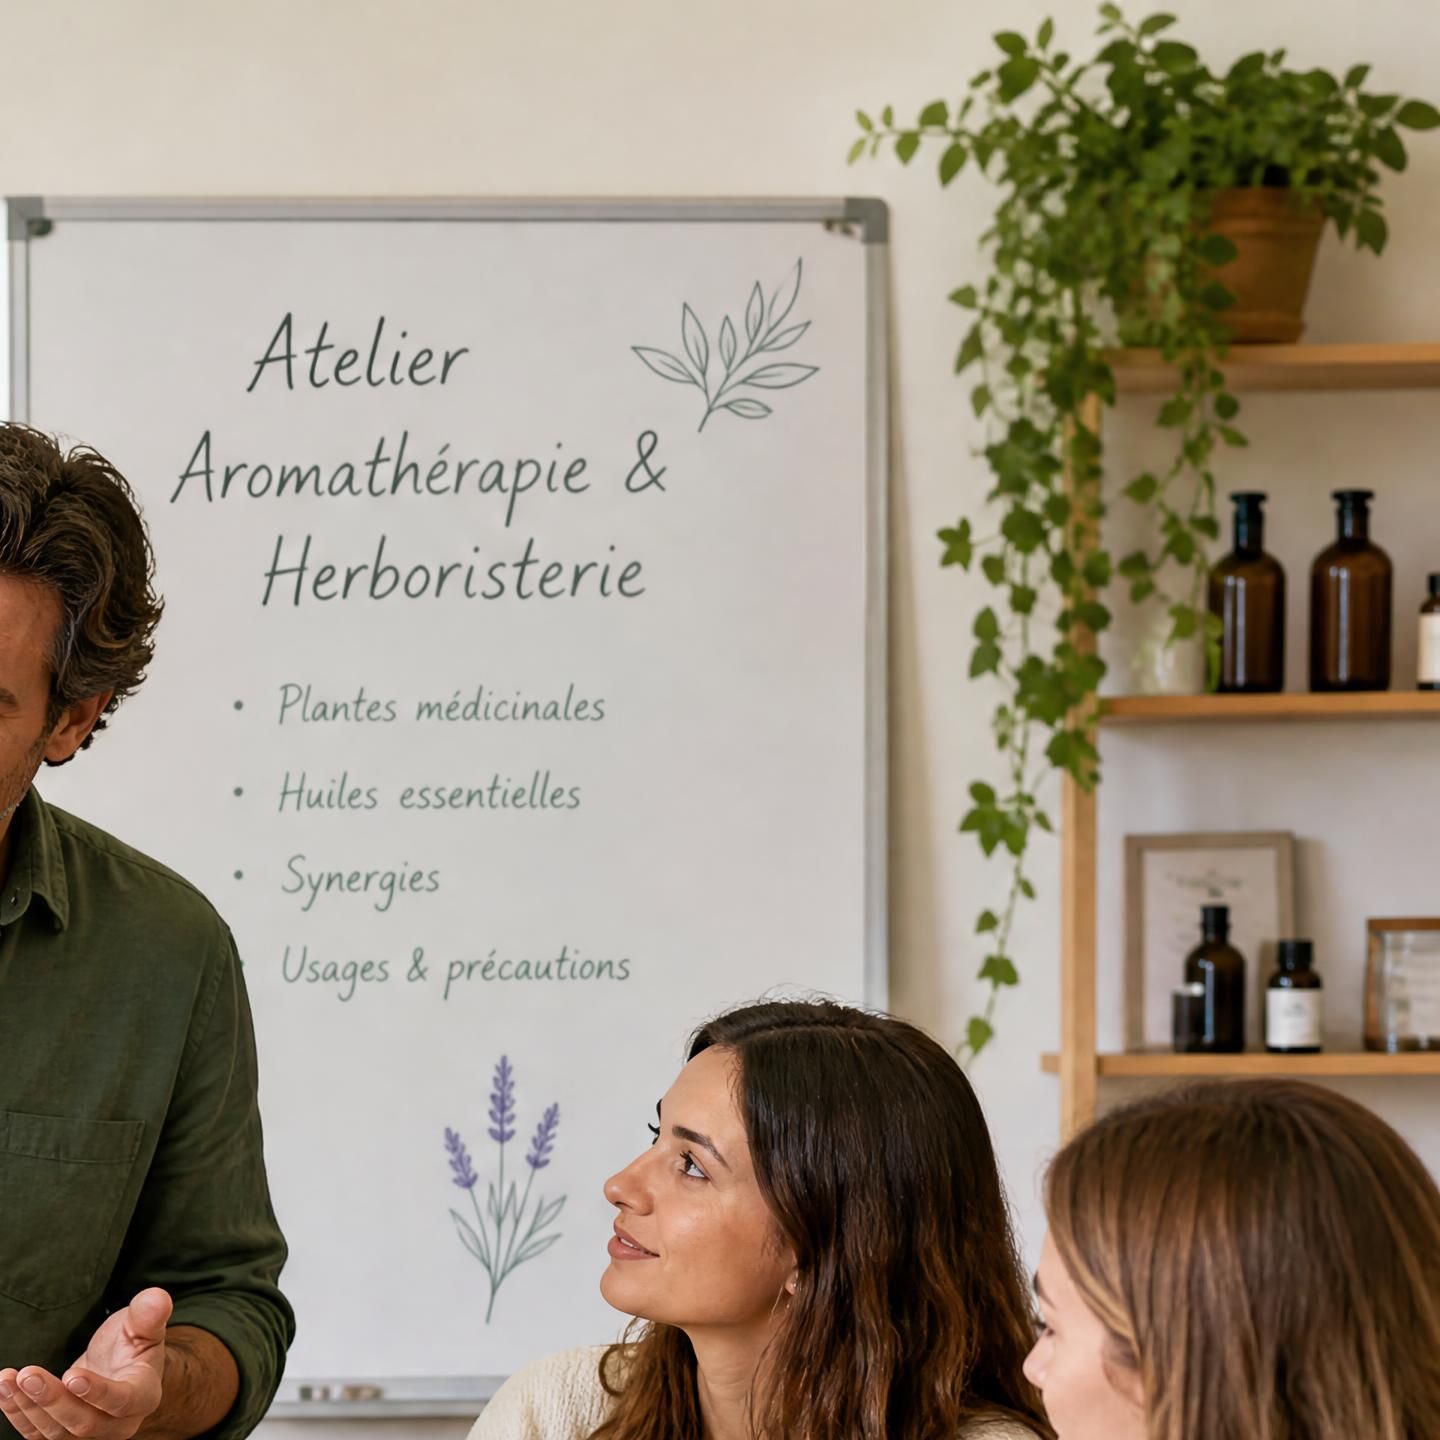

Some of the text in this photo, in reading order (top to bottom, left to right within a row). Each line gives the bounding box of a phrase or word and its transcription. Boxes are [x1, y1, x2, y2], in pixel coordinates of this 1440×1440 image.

[245, 311, 470, 394] Atelier
[169, 429, 668, 528] Aromathérapie &
[261, 534, 646, 608] Herboristerie
[278, 682, 605, 725] Plantes médicinales
[278, 769, 581, 813] Huiles essentielles
[281, 854, 440, 913] Synergies
[282, 945, 631, 1003] Usages & précautions
